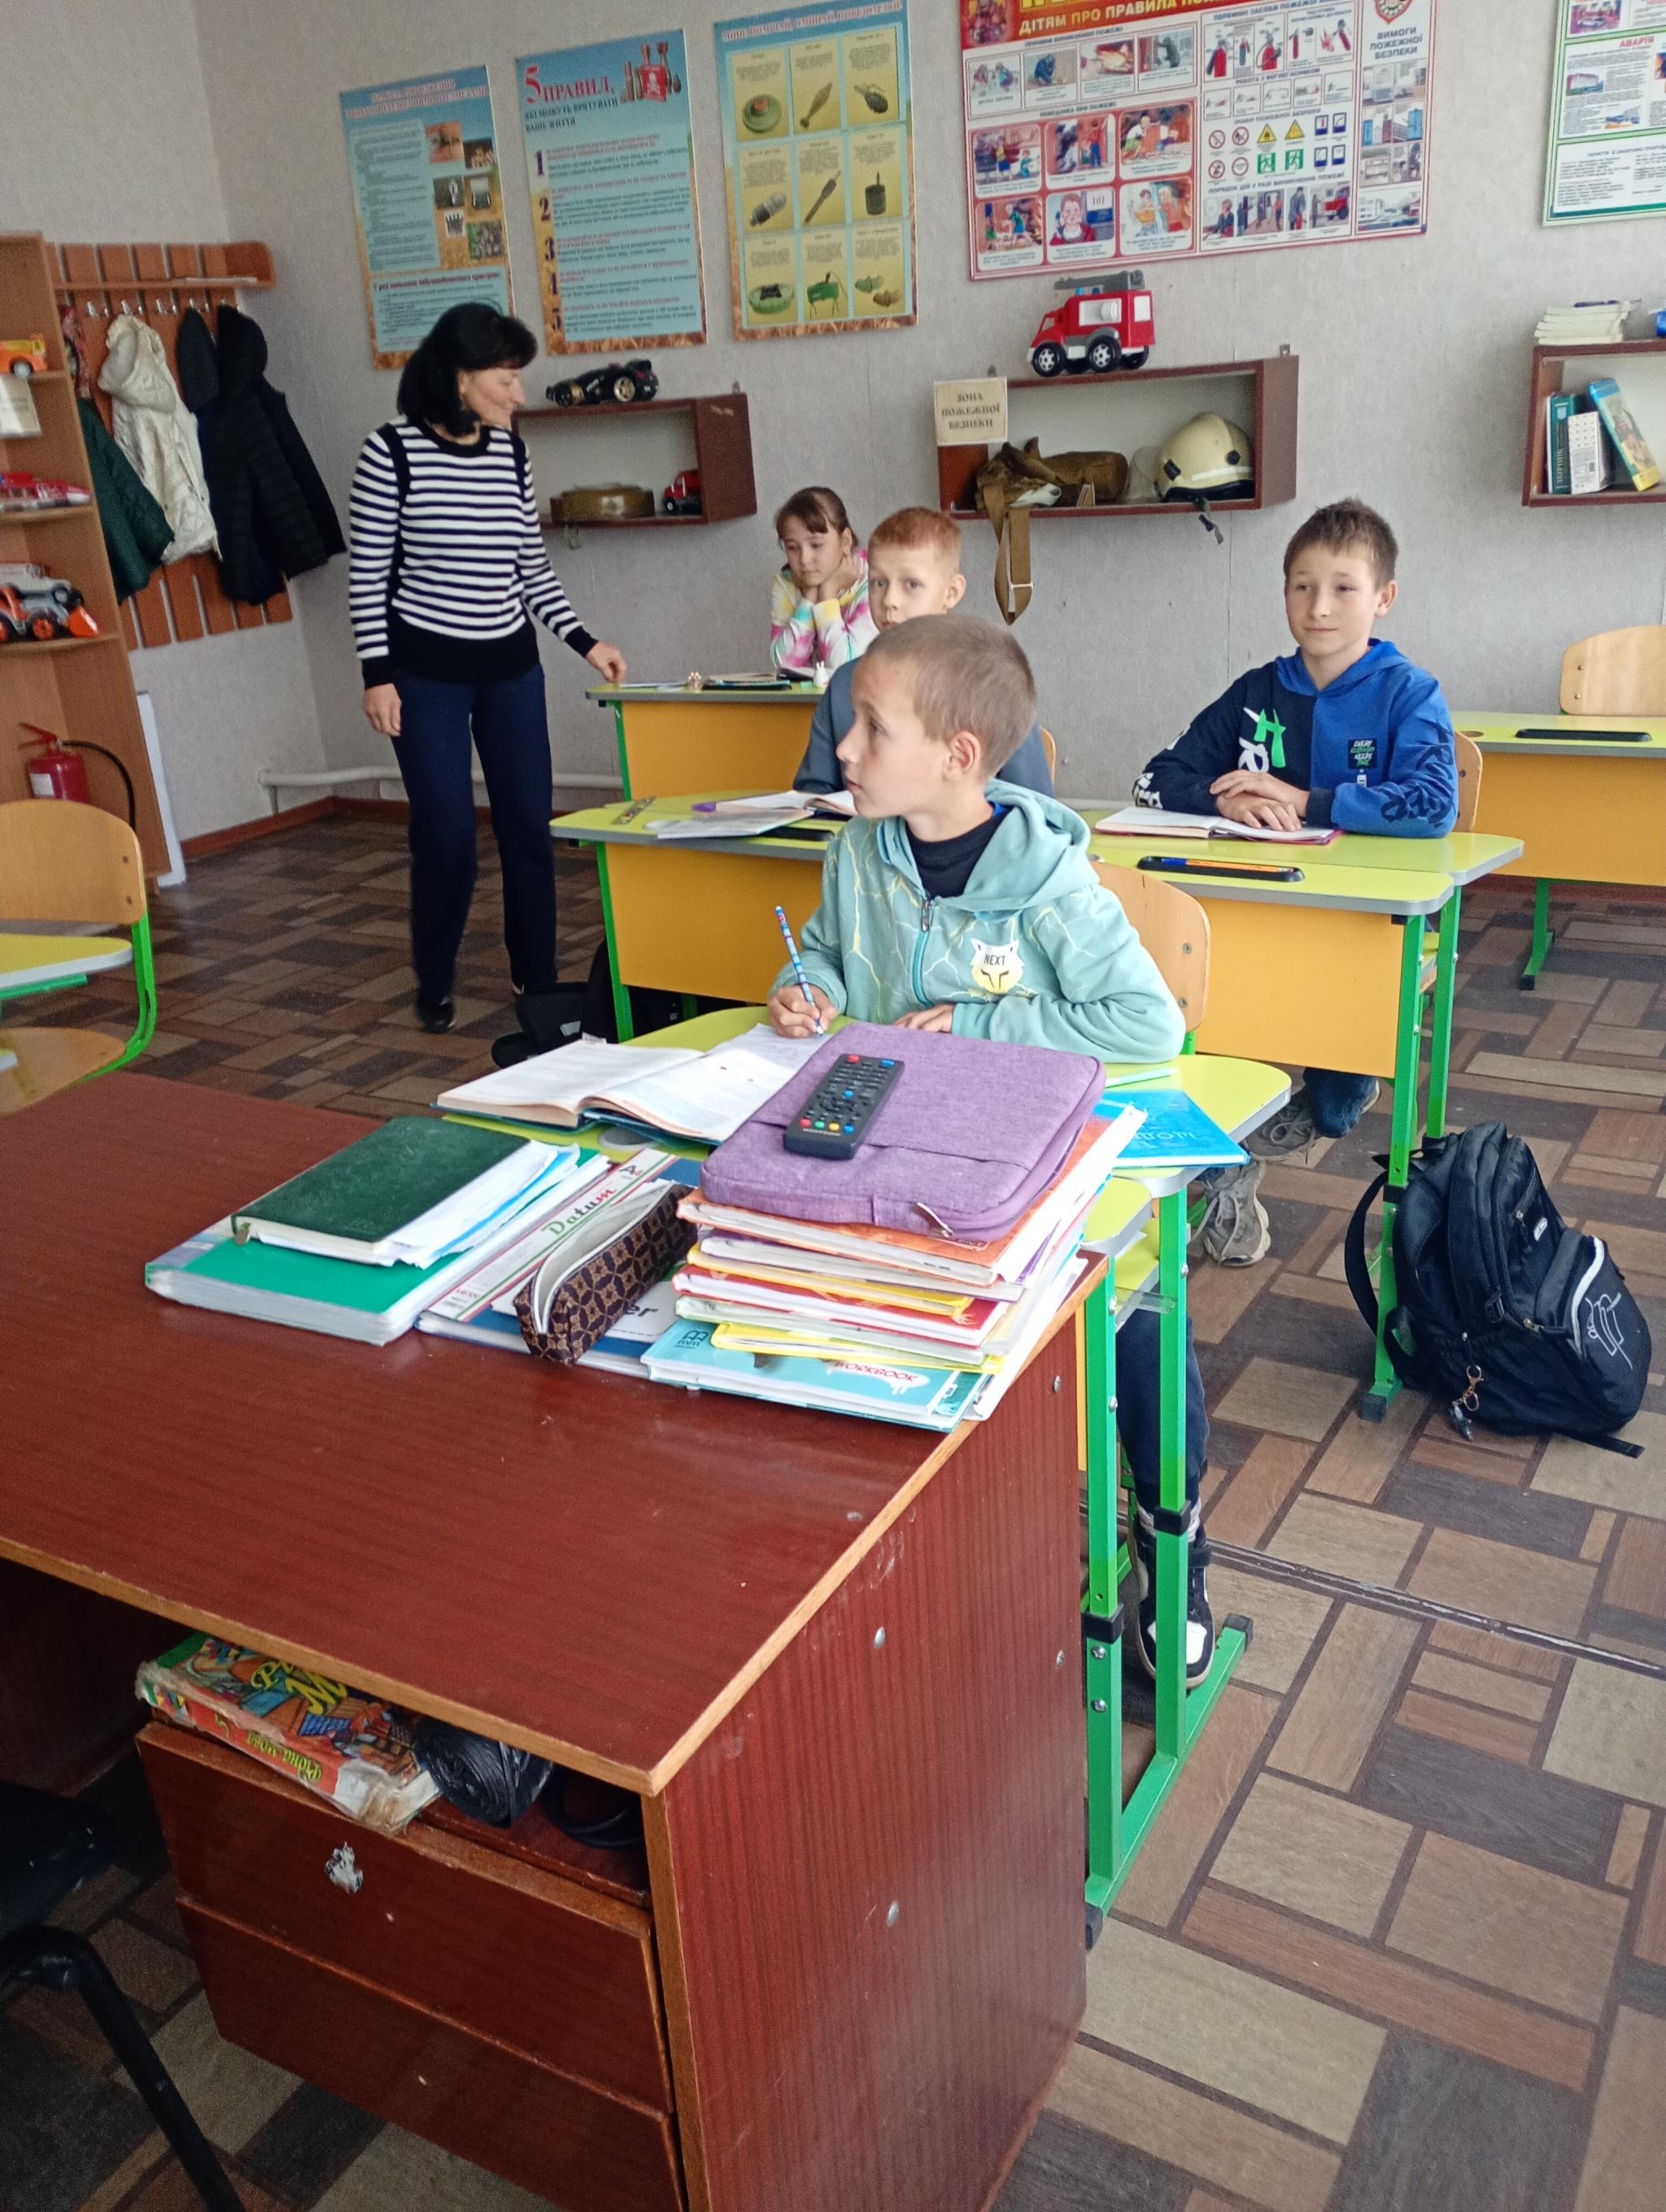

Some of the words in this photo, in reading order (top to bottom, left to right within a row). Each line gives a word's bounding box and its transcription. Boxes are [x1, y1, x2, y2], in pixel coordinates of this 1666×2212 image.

[1018, 15, 1066, 36] ДІТЯМ
[1071, 8, 1101, 25] ПРО
[1105, 0, 1177, 20] ПРАВИЛА
[1370, 34, 1423, 50] ПОЖЕЖНОЇ
[1376, 26, 1417, 40] ВИМОГИ
[1620, 36, 1655, 48] АВАРІЯ
[1375, 46, 1418, 59] БЕЗПЕКИ
[525, 64, 542, 104] 5
[536, 150, 544, 176] 1
[539, 197, 551, 221] 2
[544, 237, 555, 261] 3
[546, 272, 558, 295] 4
[551, 307, 561, 330] 5
[957, 392, 983, 403] ЗОНА
[941, 403, 1001, 417] ПОЖЕЖНОЇ
[983, 953, 1006, 966] NEXT
[542, 1188, 617, 1235] Datum
[626, 1304, 659, 1317] er
[834, 1361, 918, 1381] WORKBOOK
